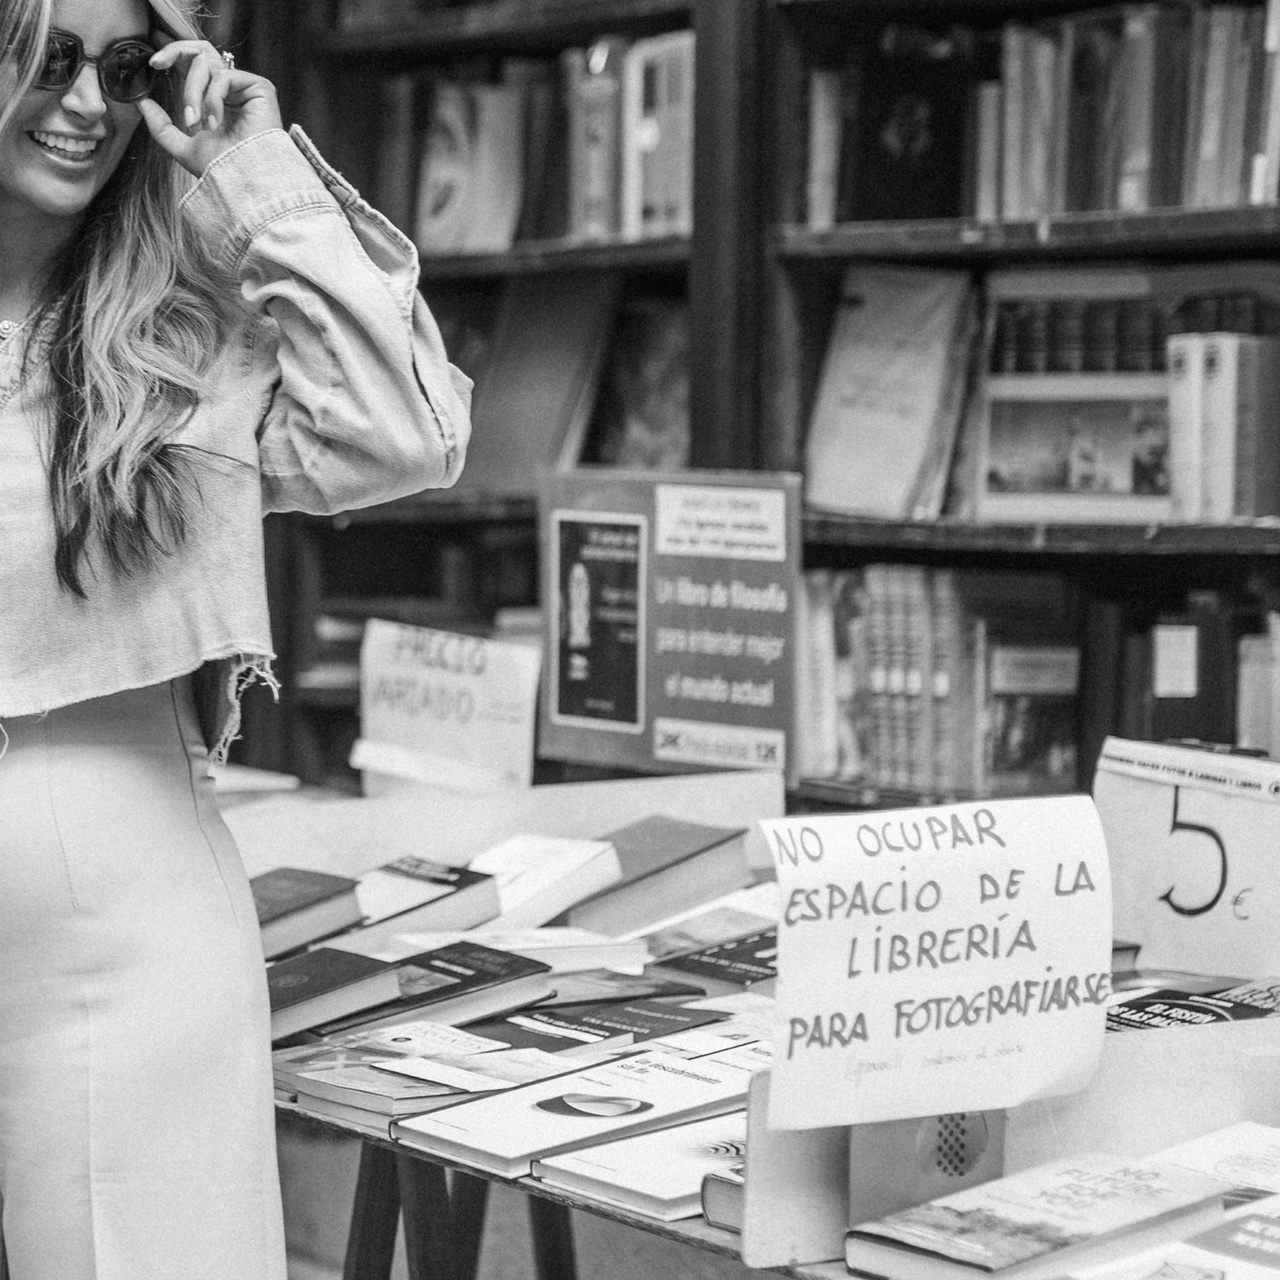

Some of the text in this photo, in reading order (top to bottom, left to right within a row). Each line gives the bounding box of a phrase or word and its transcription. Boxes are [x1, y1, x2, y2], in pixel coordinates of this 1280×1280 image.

[773, 808, 1007, 867] NO OCUPAR
[784, 860, 1097, 927] ESPACIO DE LA
[786, 965, 1114, 1061] PARA FOTOGRAFIARSE
